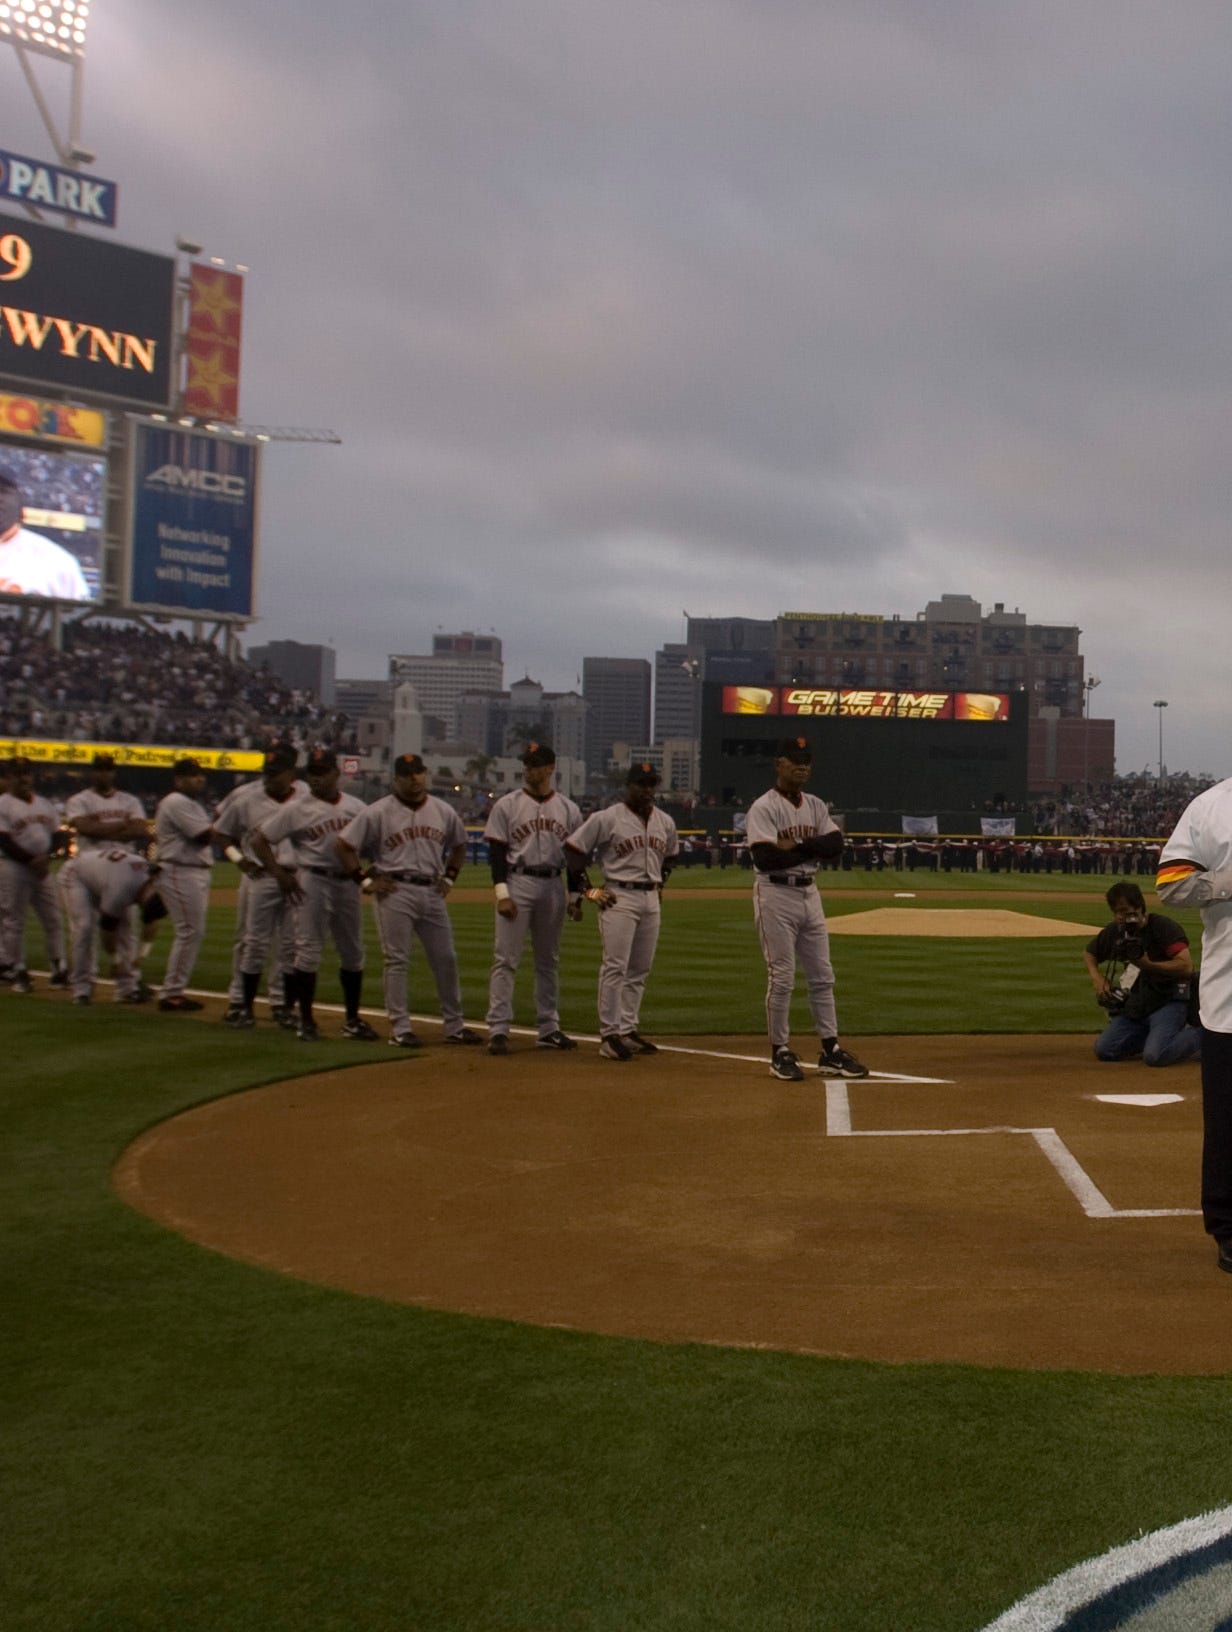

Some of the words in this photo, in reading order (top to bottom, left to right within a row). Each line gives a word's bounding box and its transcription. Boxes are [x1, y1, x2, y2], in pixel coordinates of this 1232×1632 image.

[8, 158, 108, 220] PARK
[0, 305, 156, 374] WYNN
[144, 463, 245, 496] AMCC
[157, 521, 231, 551] Networking
[160, 543, 227, 567] Innovation
[154, 565, 183, 582] with
[186, 567, 231, 589] Impact
[787, 690, 876, 706] GAME
[878, 692, 949, 708] TIME
[797, 704, 938, 719] BUDWEISER
